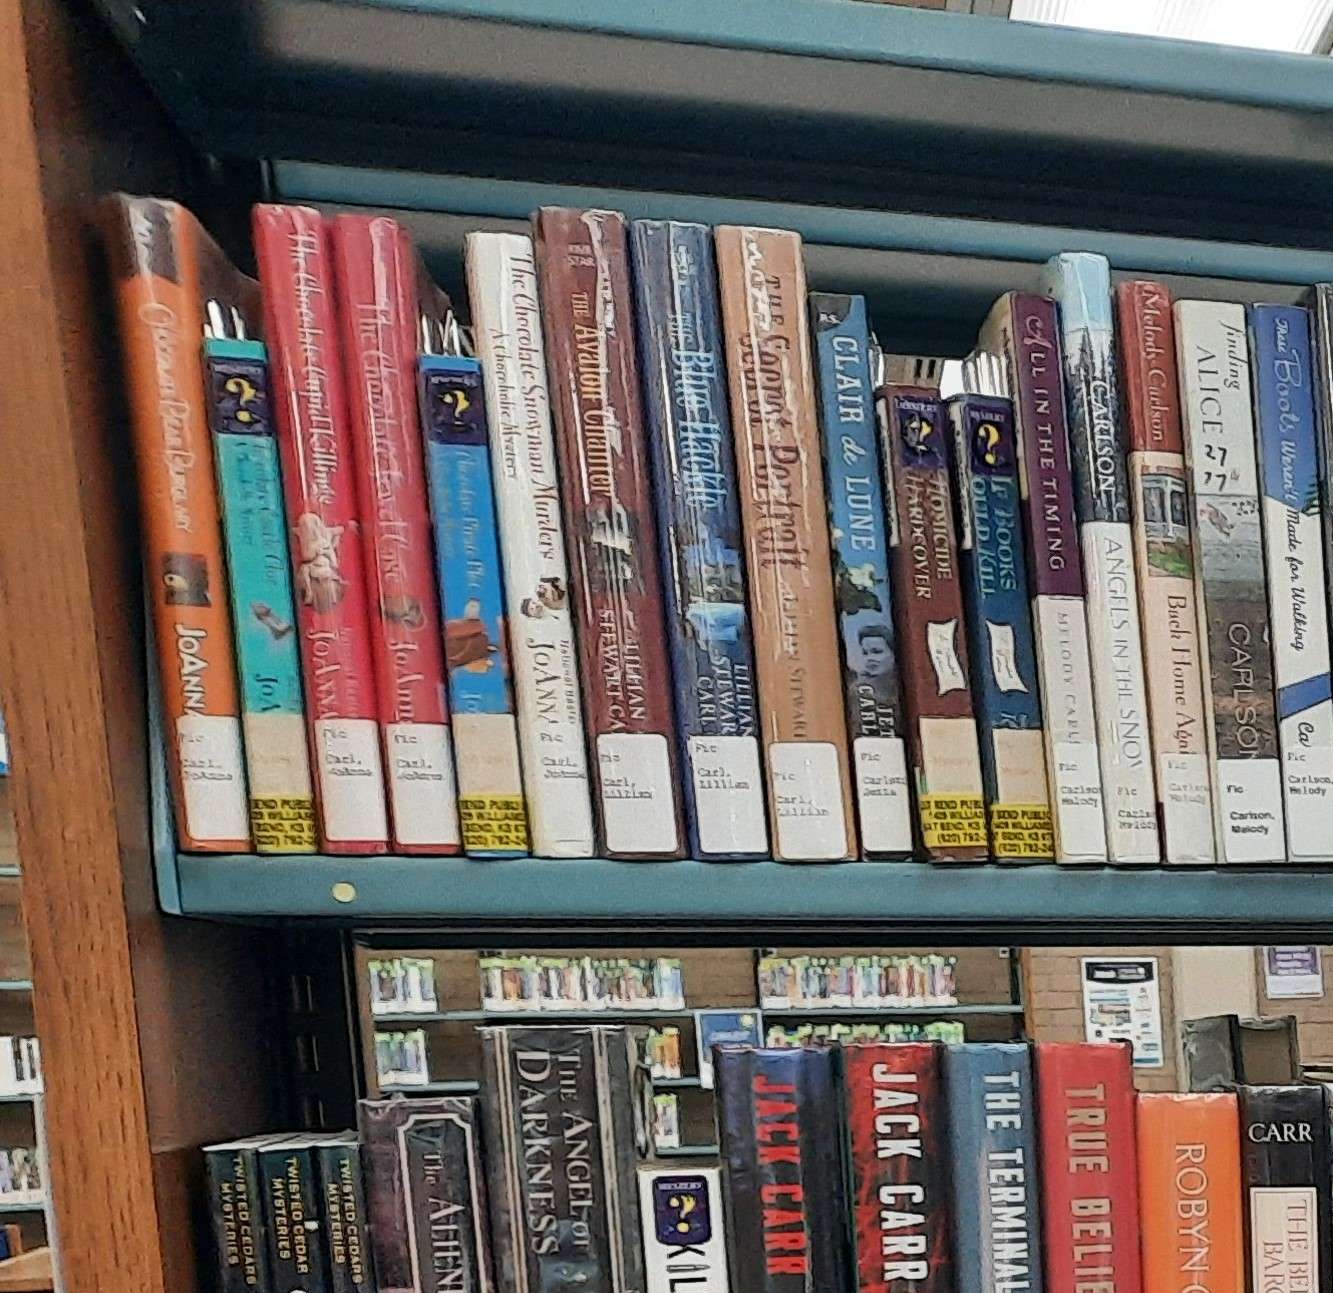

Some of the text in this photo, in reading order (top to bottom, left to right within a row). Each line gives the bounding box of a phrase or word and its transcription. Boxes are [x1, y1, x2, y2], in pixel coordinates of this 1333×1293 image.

[513, 289, 561, 561] Chocolate Snowman Murders
[830, 335, 877, 553] CLAIR LUNE
[1089, 379, 1119, 494] CARLSON
[1195, 344, 1224, 434] ALICE
[1037, 423, 1067, 572] THE TIMING
[1272, 348, 1309, 653] Boots Walking
[1104, 538, 1130, 632] ANGELS
[1166, 593, 1194, 707] Back Home
[1226, 784, 1245, 795] Fic
[515, 1051, 560, 1256] DARKNESS
[983, 1070, 1022, 1132] THE
[1064, 1083, 1110, 1176] TRUE
[1247, 1122, 1315, 1144] CARR
[560, 1110, 594, 1217] ANGEL
[752, 1074, 809, 1278] JACK CARR
[870, 1063, 930, 1284] JACK CARR
[1175, 1141, 1213, 1269] ROBYN
[1286, 1198, 1308, 1252] THE
